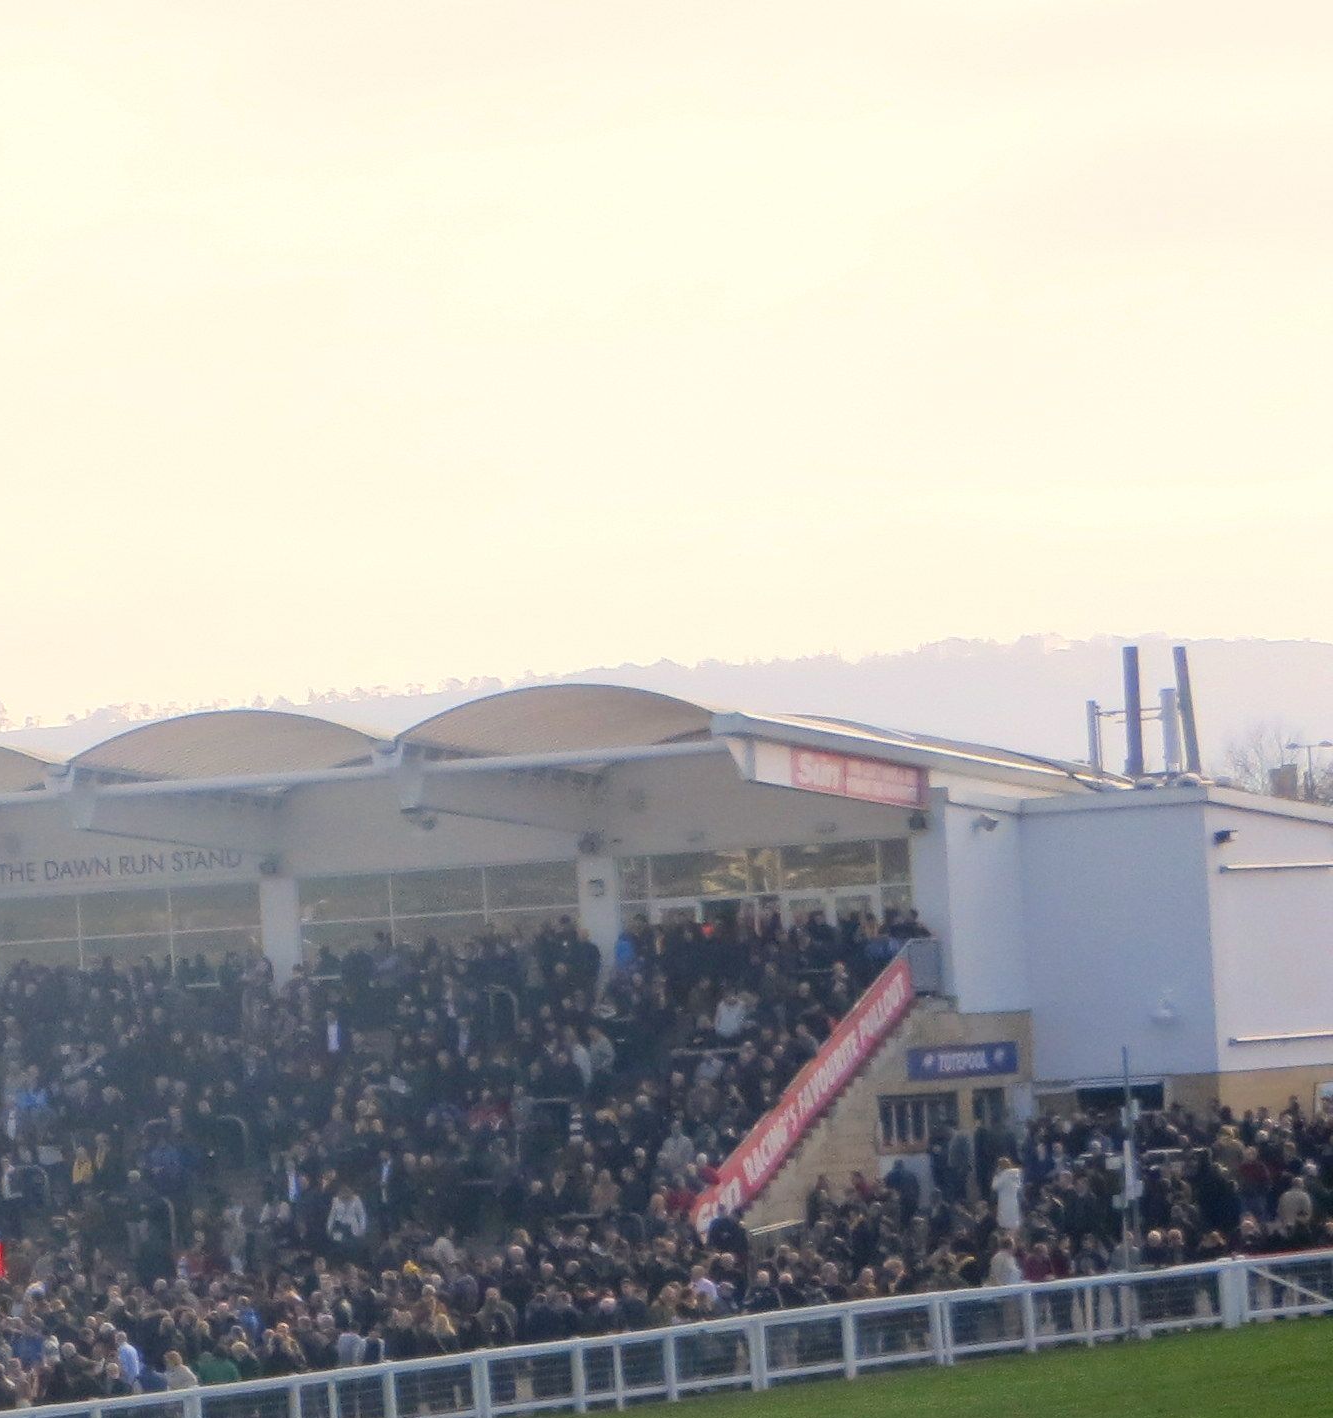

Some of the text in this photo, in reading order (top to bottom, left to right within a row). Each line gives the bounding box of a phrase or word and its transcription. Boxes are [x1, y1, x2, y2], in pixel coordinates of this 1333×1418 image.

[44, 858, 111, 881] DAWN
[119, 854, 164, 876] RUN
[172, 849, 242, 873] STAND
